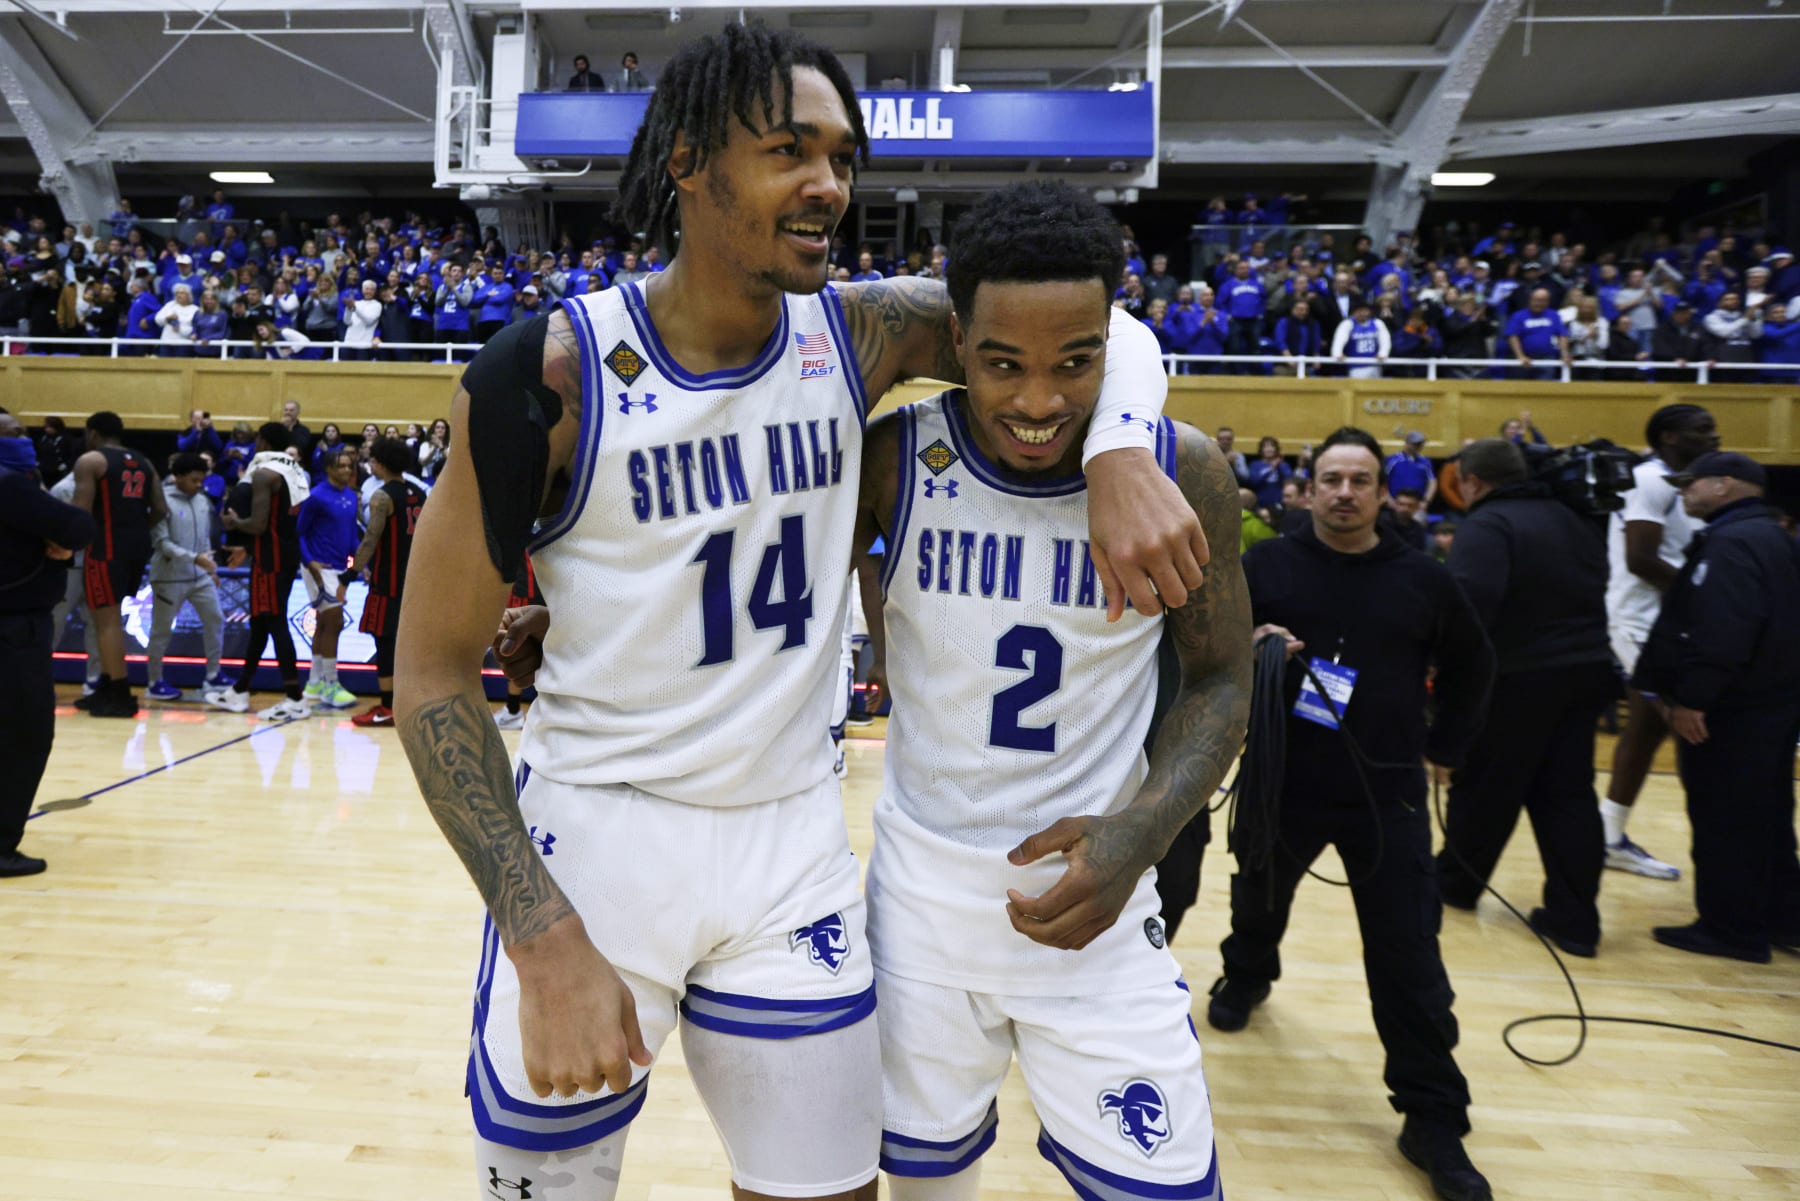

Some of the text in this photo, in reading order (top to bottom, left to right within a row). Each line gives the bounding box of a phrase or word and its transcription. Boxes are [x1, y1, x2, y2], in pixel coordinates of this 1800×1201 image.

[800, 365, 837, 376] EAST
[802, 359, 826, 368] BIG
[1363, 399, 1433, 415] COURT
[121, 469, 146, 498] 22
[627, 417, 843, 524] SETON HALL
[688, 511, 815, 672] 14
[917, 527, 1135, 609] SETON HA
[985, 622, 1065, 753] 2
